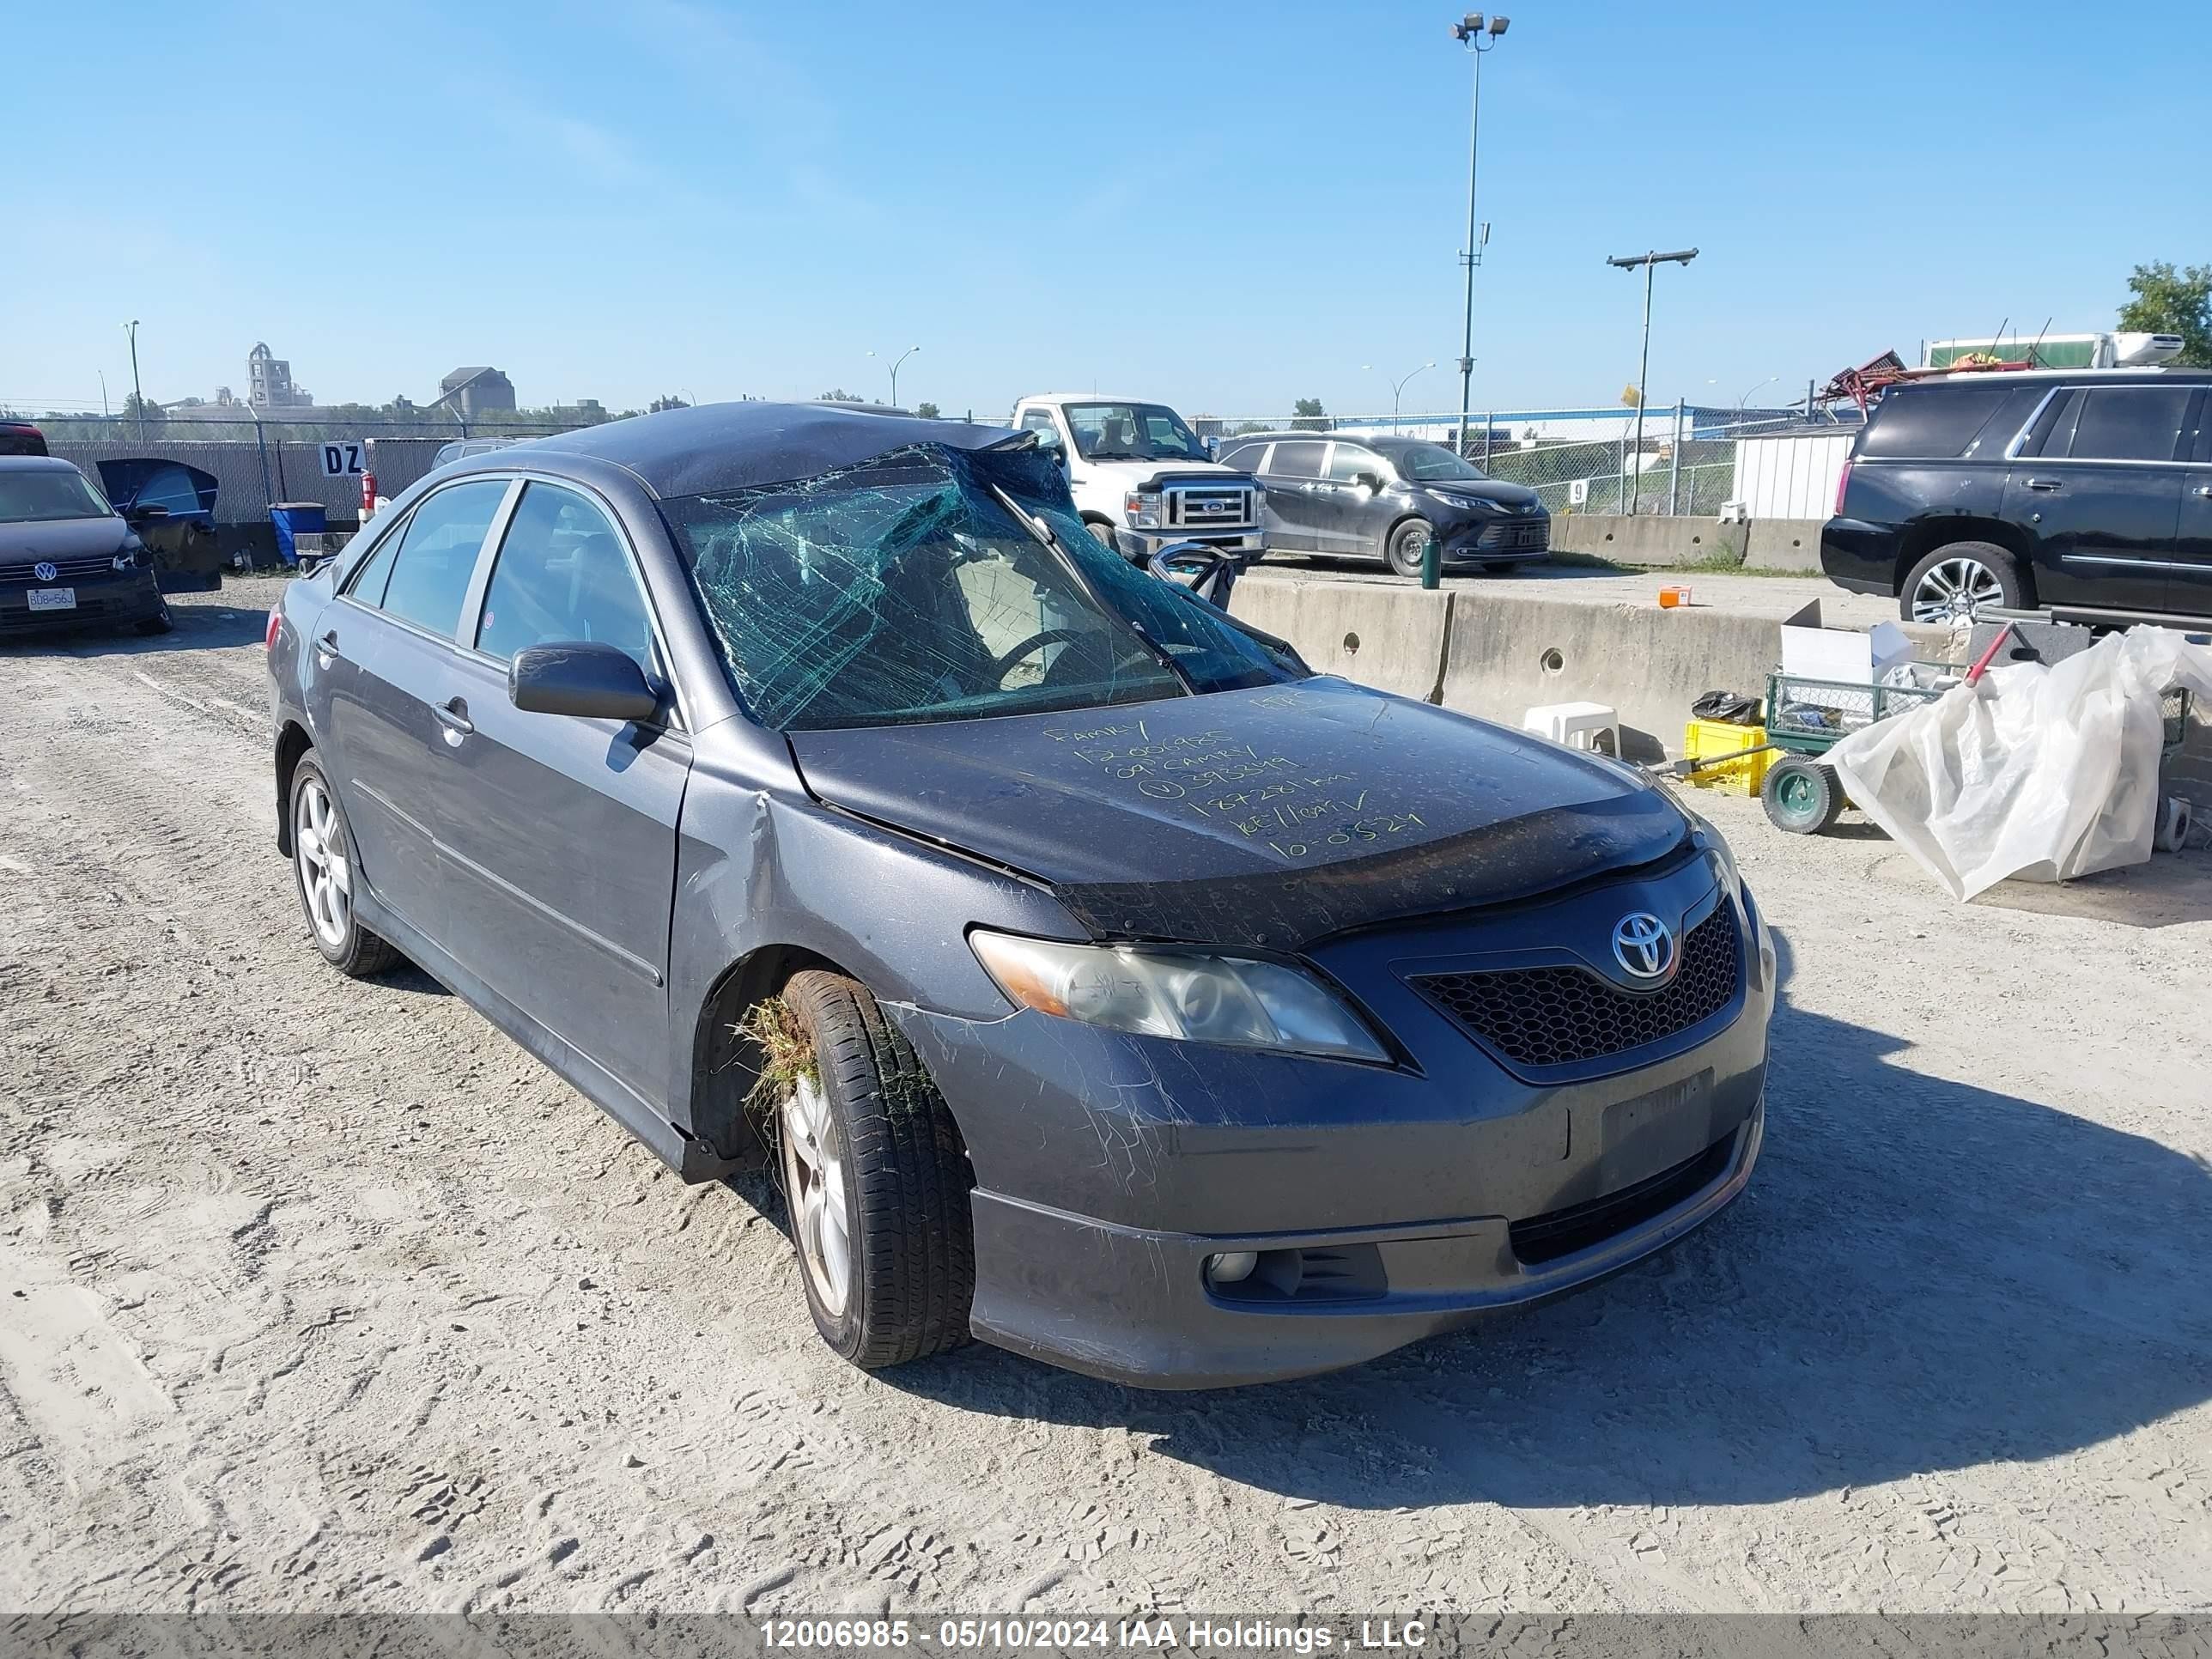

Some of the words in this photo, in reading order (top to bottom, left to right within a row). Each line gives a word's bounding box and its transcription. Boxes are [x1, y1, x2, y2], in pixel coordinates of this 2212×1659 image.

[325, 446, 362, 474] DZ
[1575, 483, 1582, 501] 9
[1073, 730, 1233, 765] 12006985
[1164, 744, 1259, 770] CAMRY
[1181, 757, 1300, 790] 393349
[1188, 781, 1305, 817] 187281
